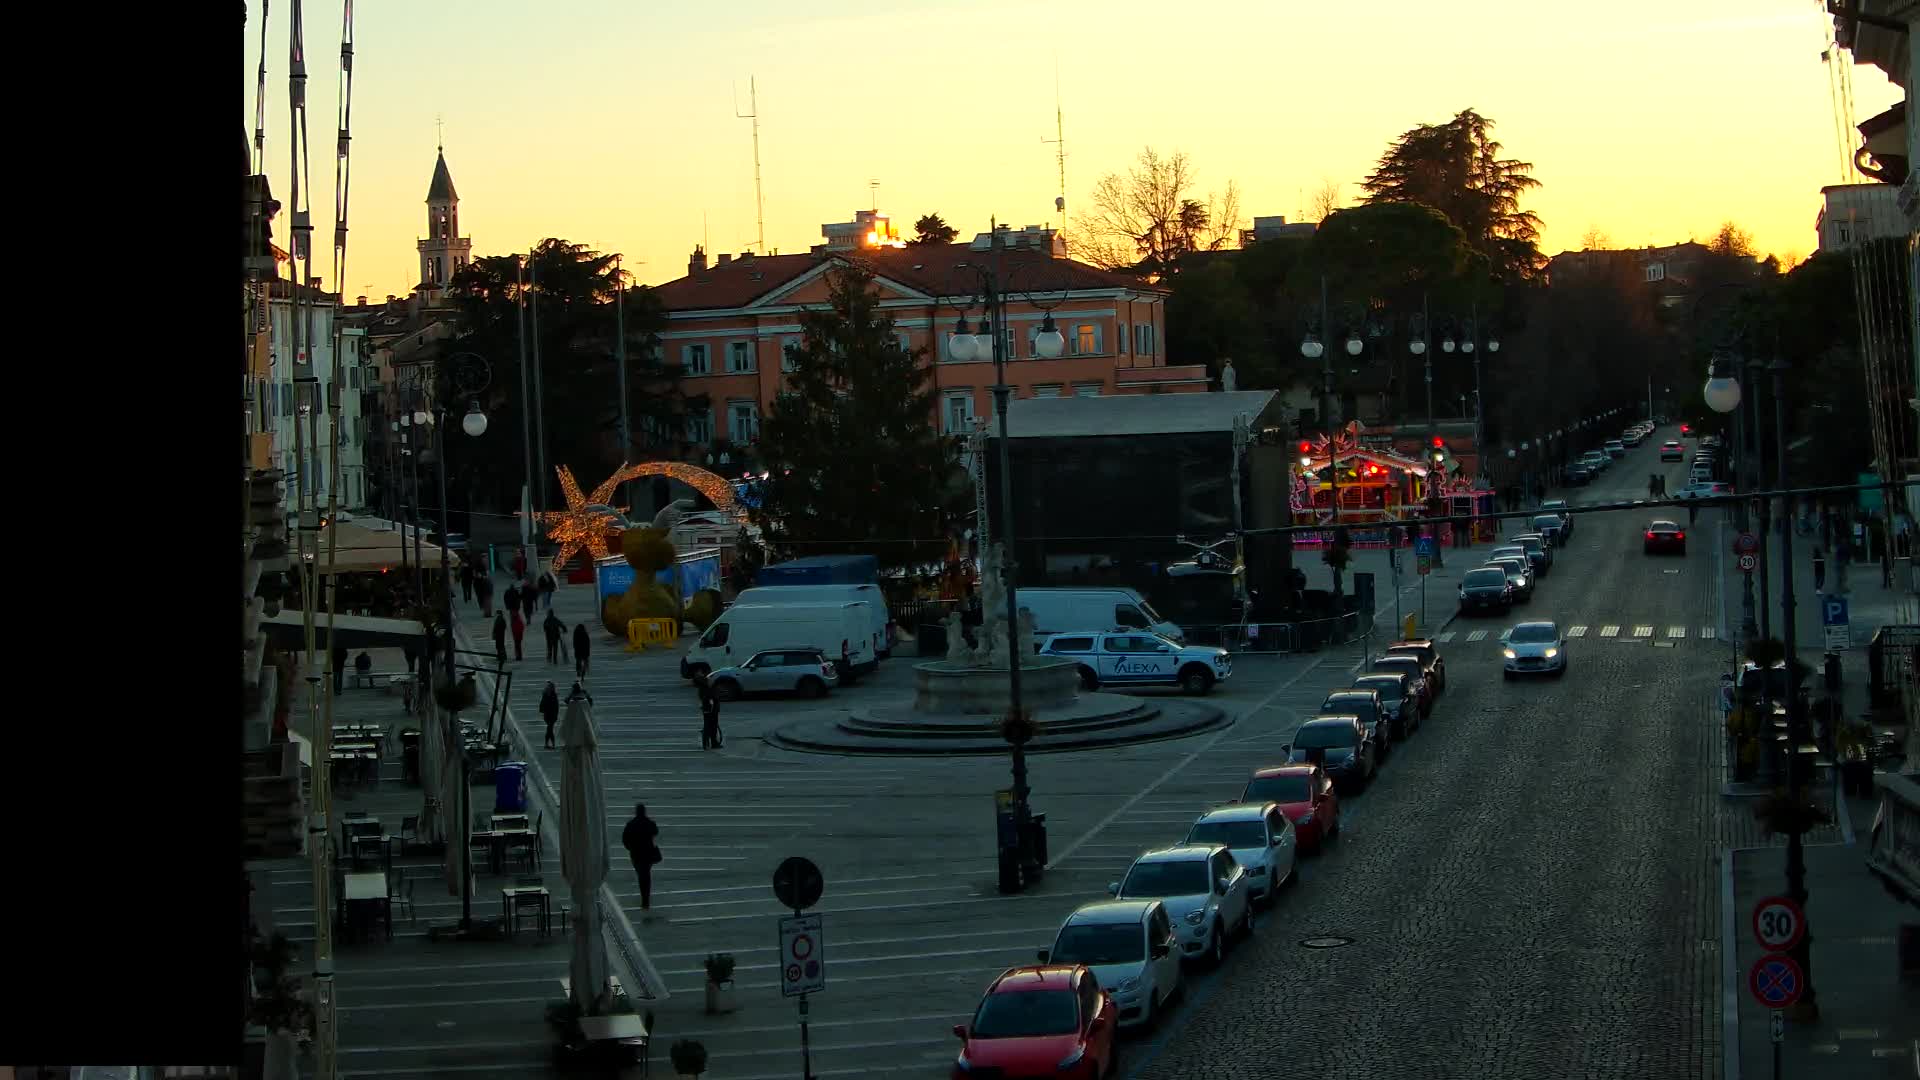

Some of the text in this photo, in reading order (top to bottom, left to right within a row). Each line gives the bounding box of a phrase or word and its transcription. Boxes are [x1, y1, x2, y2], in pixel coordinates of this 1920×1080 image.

[1827, 602, 1842, 622] P
[1115, 660, 1161, 673] ALEXA
[1763, 911, 1792, 937] 30
